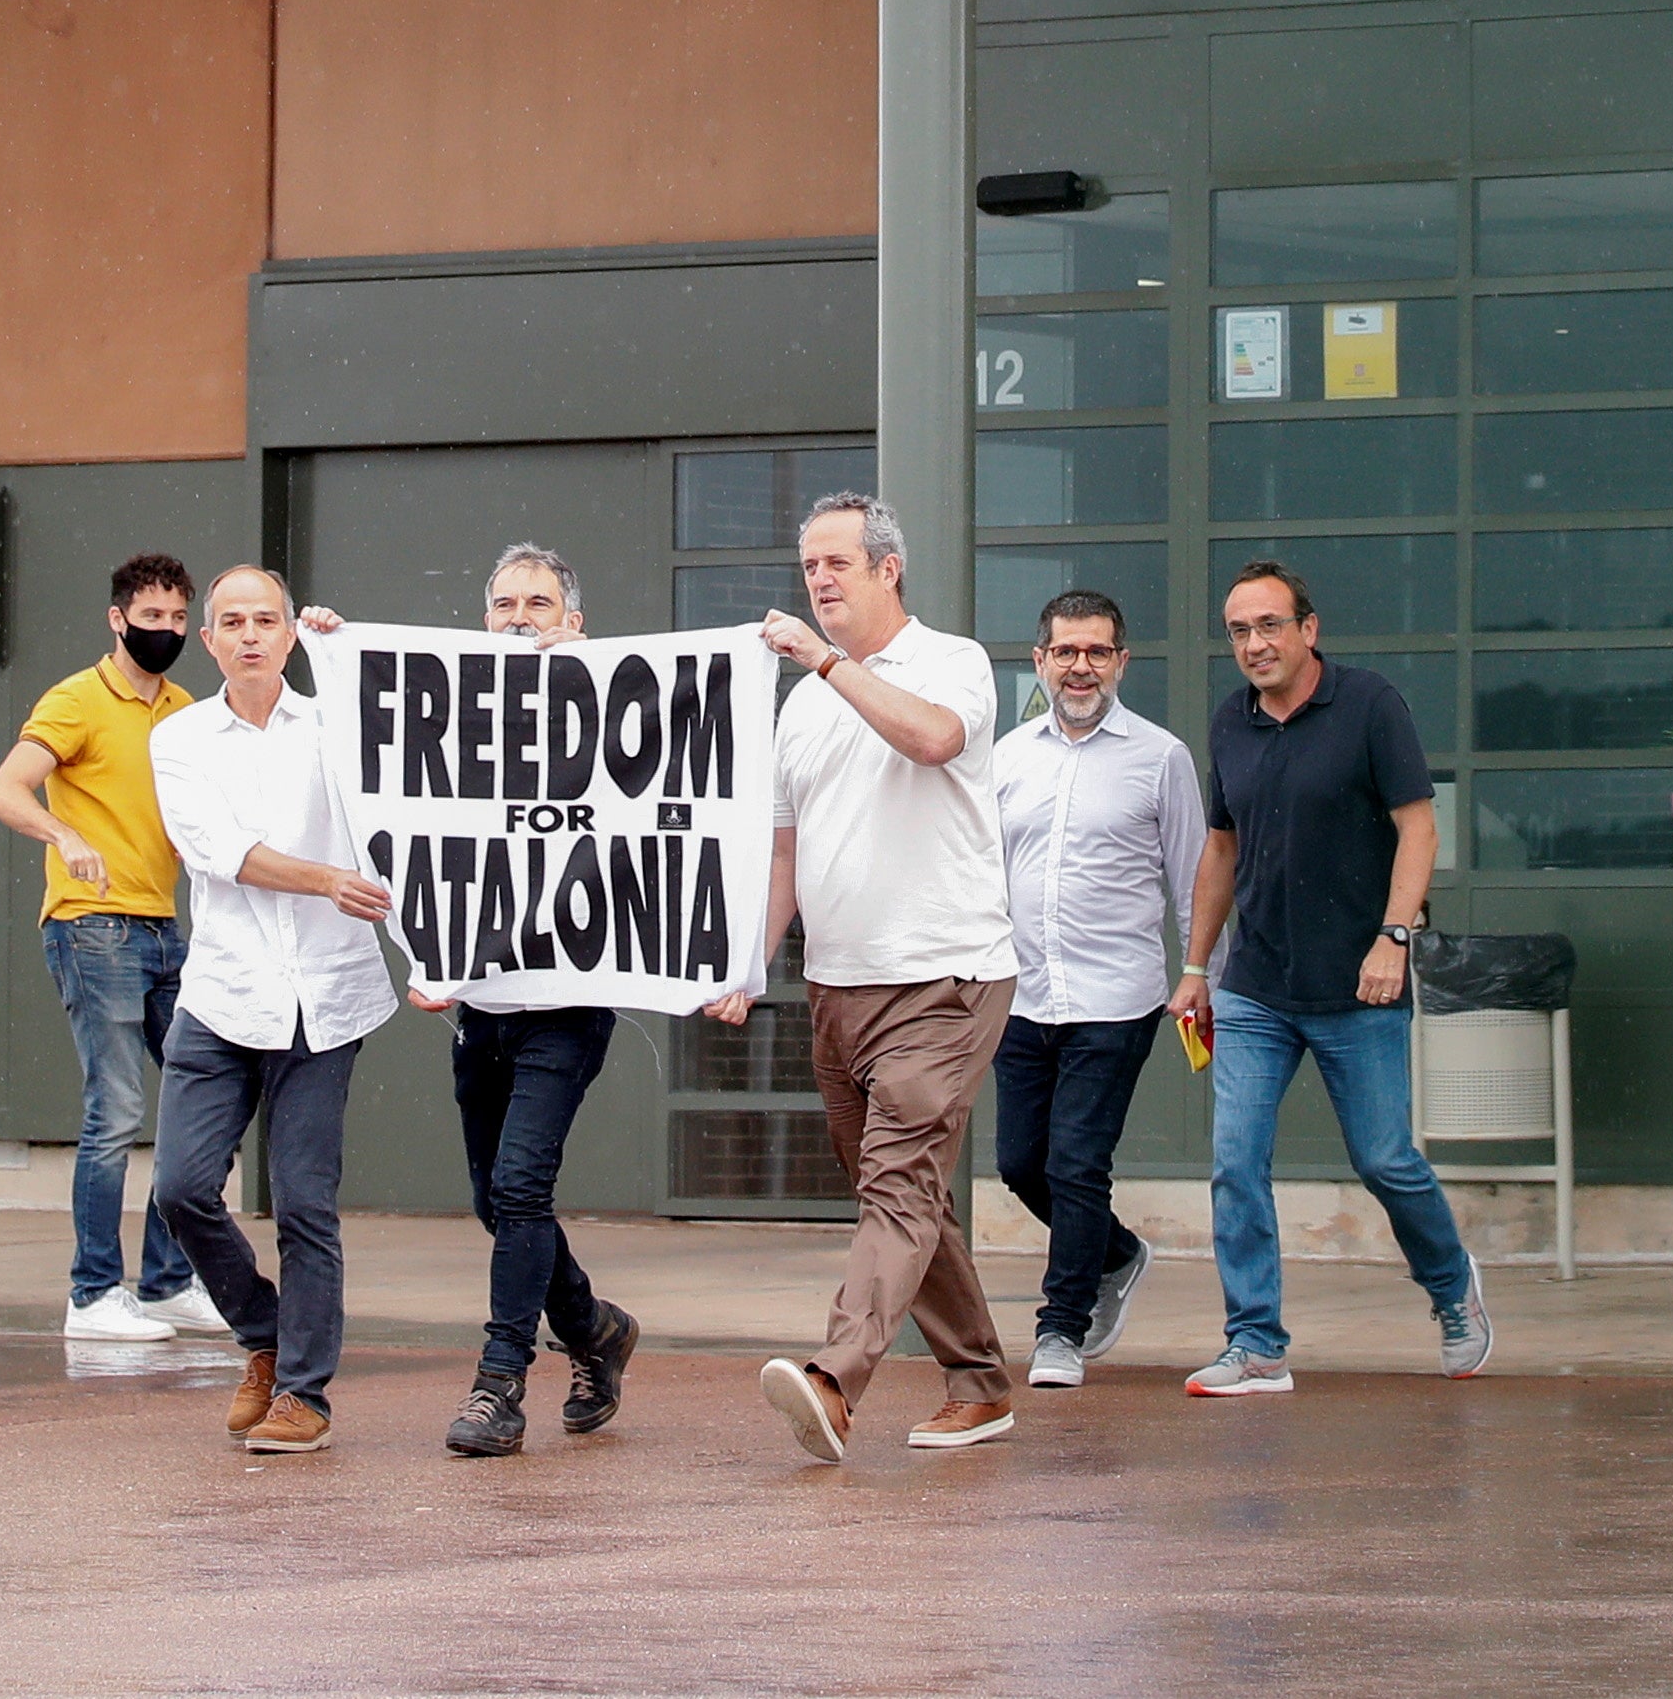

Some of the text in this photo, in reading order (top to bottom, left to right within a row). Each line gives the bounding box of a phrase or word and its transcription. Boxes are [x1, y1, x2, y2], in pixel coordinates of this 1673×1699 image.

[976, 349, 1024, 406] 12
[360, 649, 733, 800] FREEDOM
[506, 804, 596, 833] FOR
